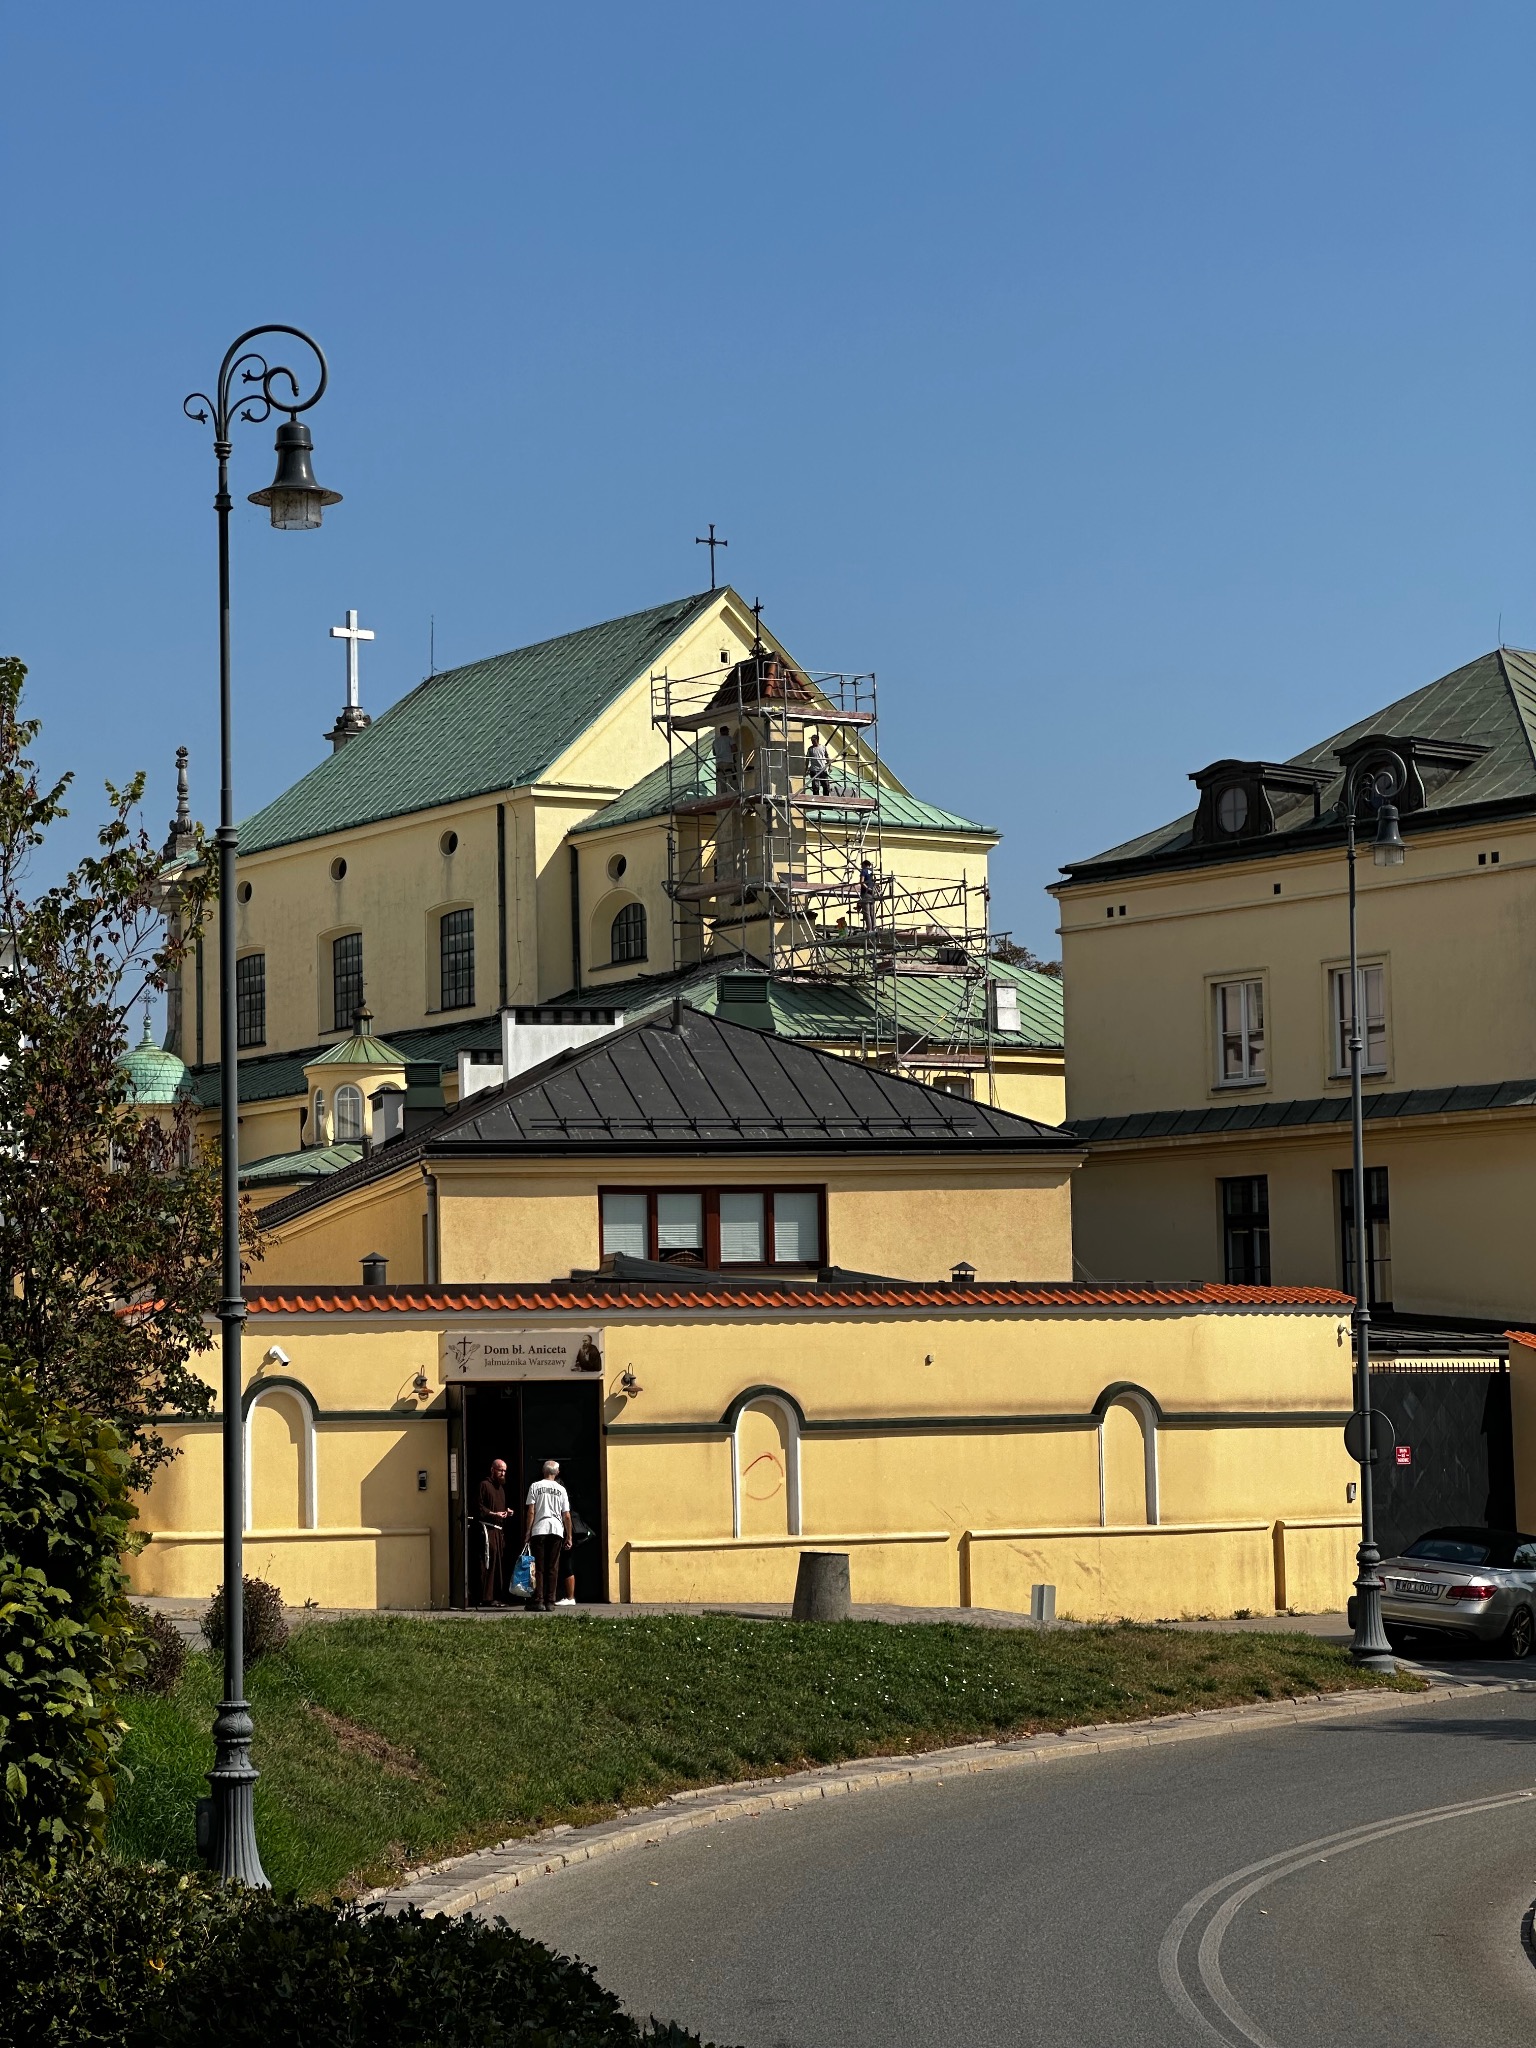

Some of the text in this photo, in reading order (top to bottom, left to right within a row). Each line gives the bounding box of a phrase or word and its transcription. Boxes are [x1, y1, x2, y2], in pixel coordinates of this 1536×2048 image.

[484, 1344, 567, 1355] Dom bł. Aniceta
[484, 1358, 567, 1368] Jałmużnika Warszawy
